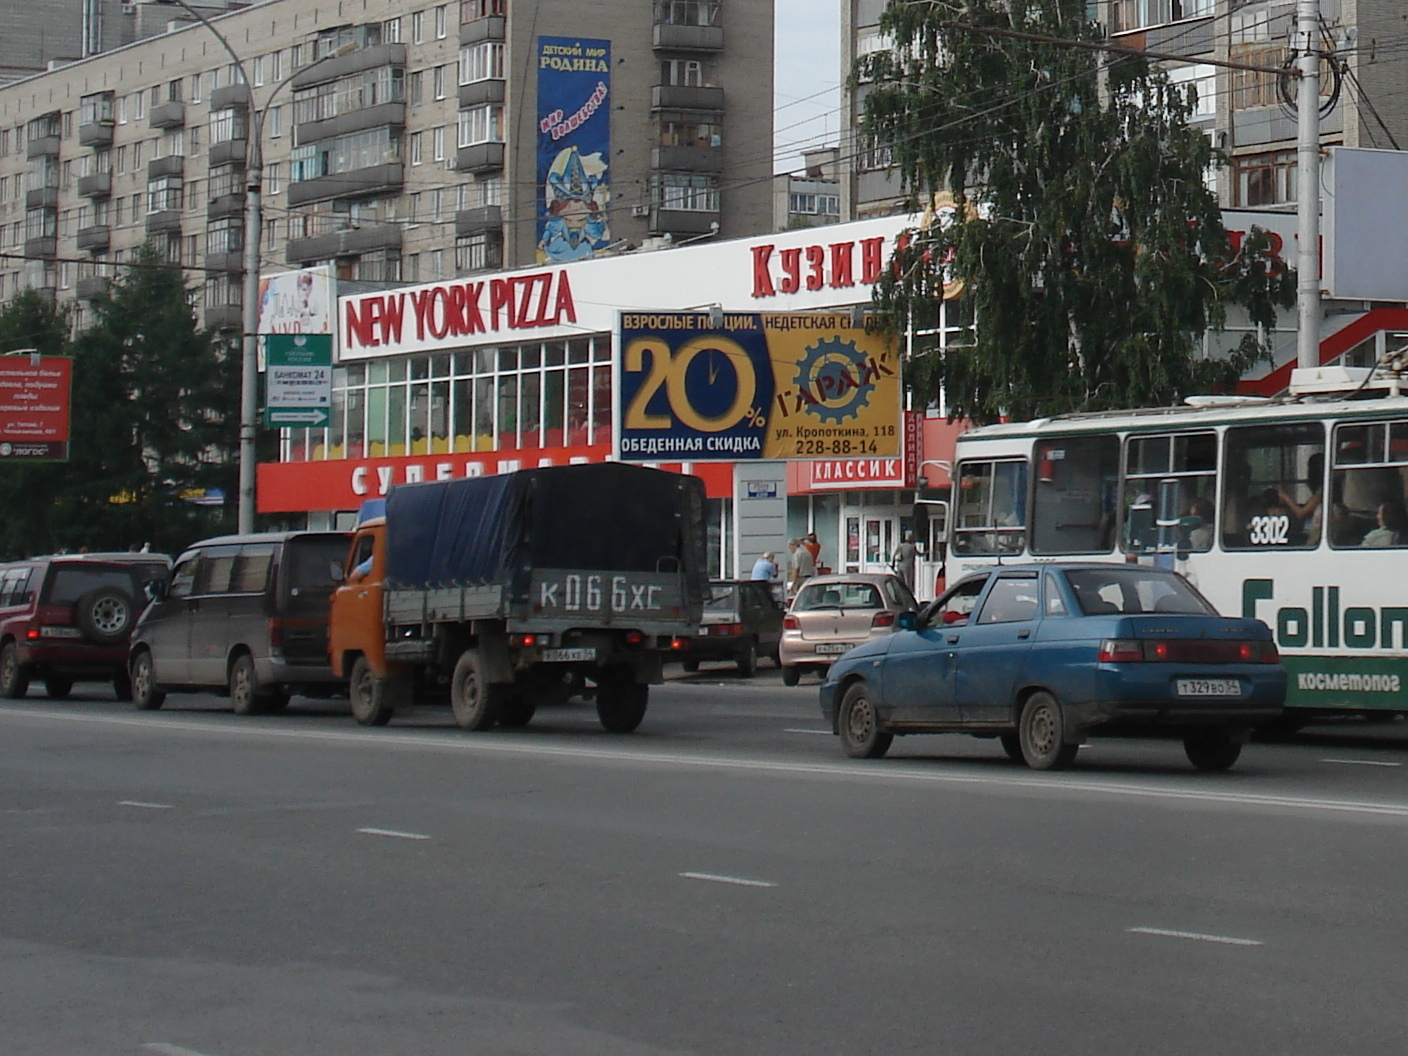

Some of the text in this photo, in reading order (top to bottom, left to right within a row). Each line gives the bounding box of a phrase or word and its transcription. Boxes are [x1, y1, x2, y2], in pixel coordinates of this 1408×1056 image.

[542, 44, 606, 57] ДЕТСКИЙ МИР
[540, 56, 608, 72] РОДИНА
[541, 109, 563, 133] МИР
[346, 292, 405, 348] NEW
[410, 281, 486, 341] YORK
[489, 269, 577, 331] PIZZA
[623, 315, 757, 332] ВЗРОСЛЫЕ ПОЦИИ.
[765, 315, 836, 331] НЕДЕТСКАЯ
[274, 370, 324, 379] БАНКОМАТ 24
[624, 334, 766, 433] 20%
[777, 352, 894, 418] ГАРАЖ
[776, 426, 895, 439] ул. Кропоткина, 118
[621, 437, 760, 454] ОБЕДЕННАЯ СКИДКА
[796, 441, 877, 454] 228-88-14
[815, 459, 896, 480] КЛАССИК
[1250, 516, 1290, 544] 3302
[1180, 680, 1224, 694] Т329ВО
